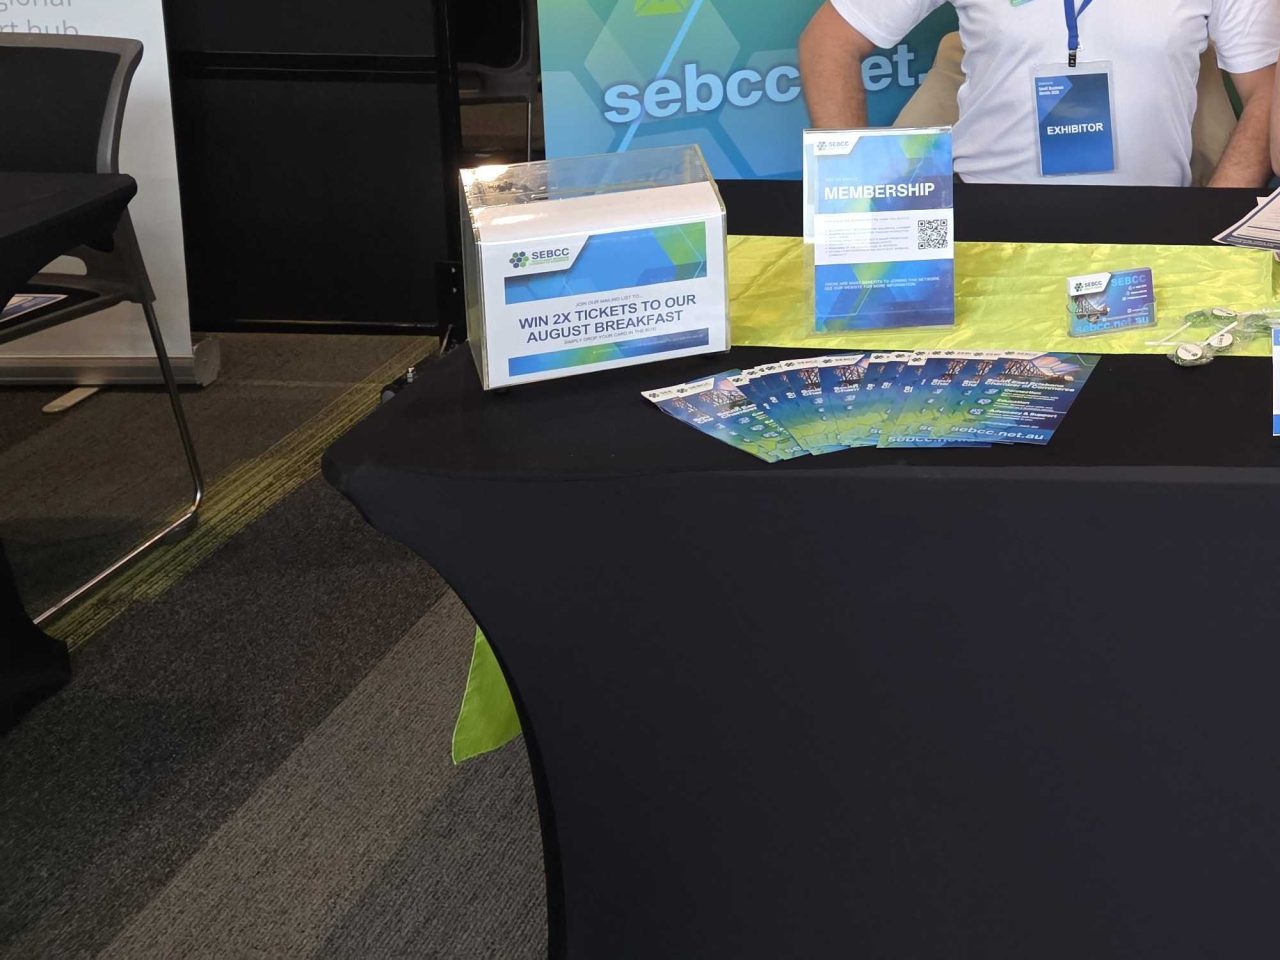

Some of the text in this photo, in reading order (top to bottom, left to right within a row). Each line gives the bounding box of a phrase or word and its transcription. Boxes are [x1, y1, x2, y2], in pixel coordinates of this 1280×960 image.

[1047, 122, 1104, 135] EXHIBITOR
[824, 182, 935, 200] MEMBERSHIP
[531, 248, 570, 260] SEBCC
[1084, 280, 1103, 288] SEBCC
[1111, 274, 1147, 287] SEBCC
[519, 294, 696, 330] WIN 2X TICKETS TO OUR
[526, 310, 683, 343] AUGUST BREAKFAST
